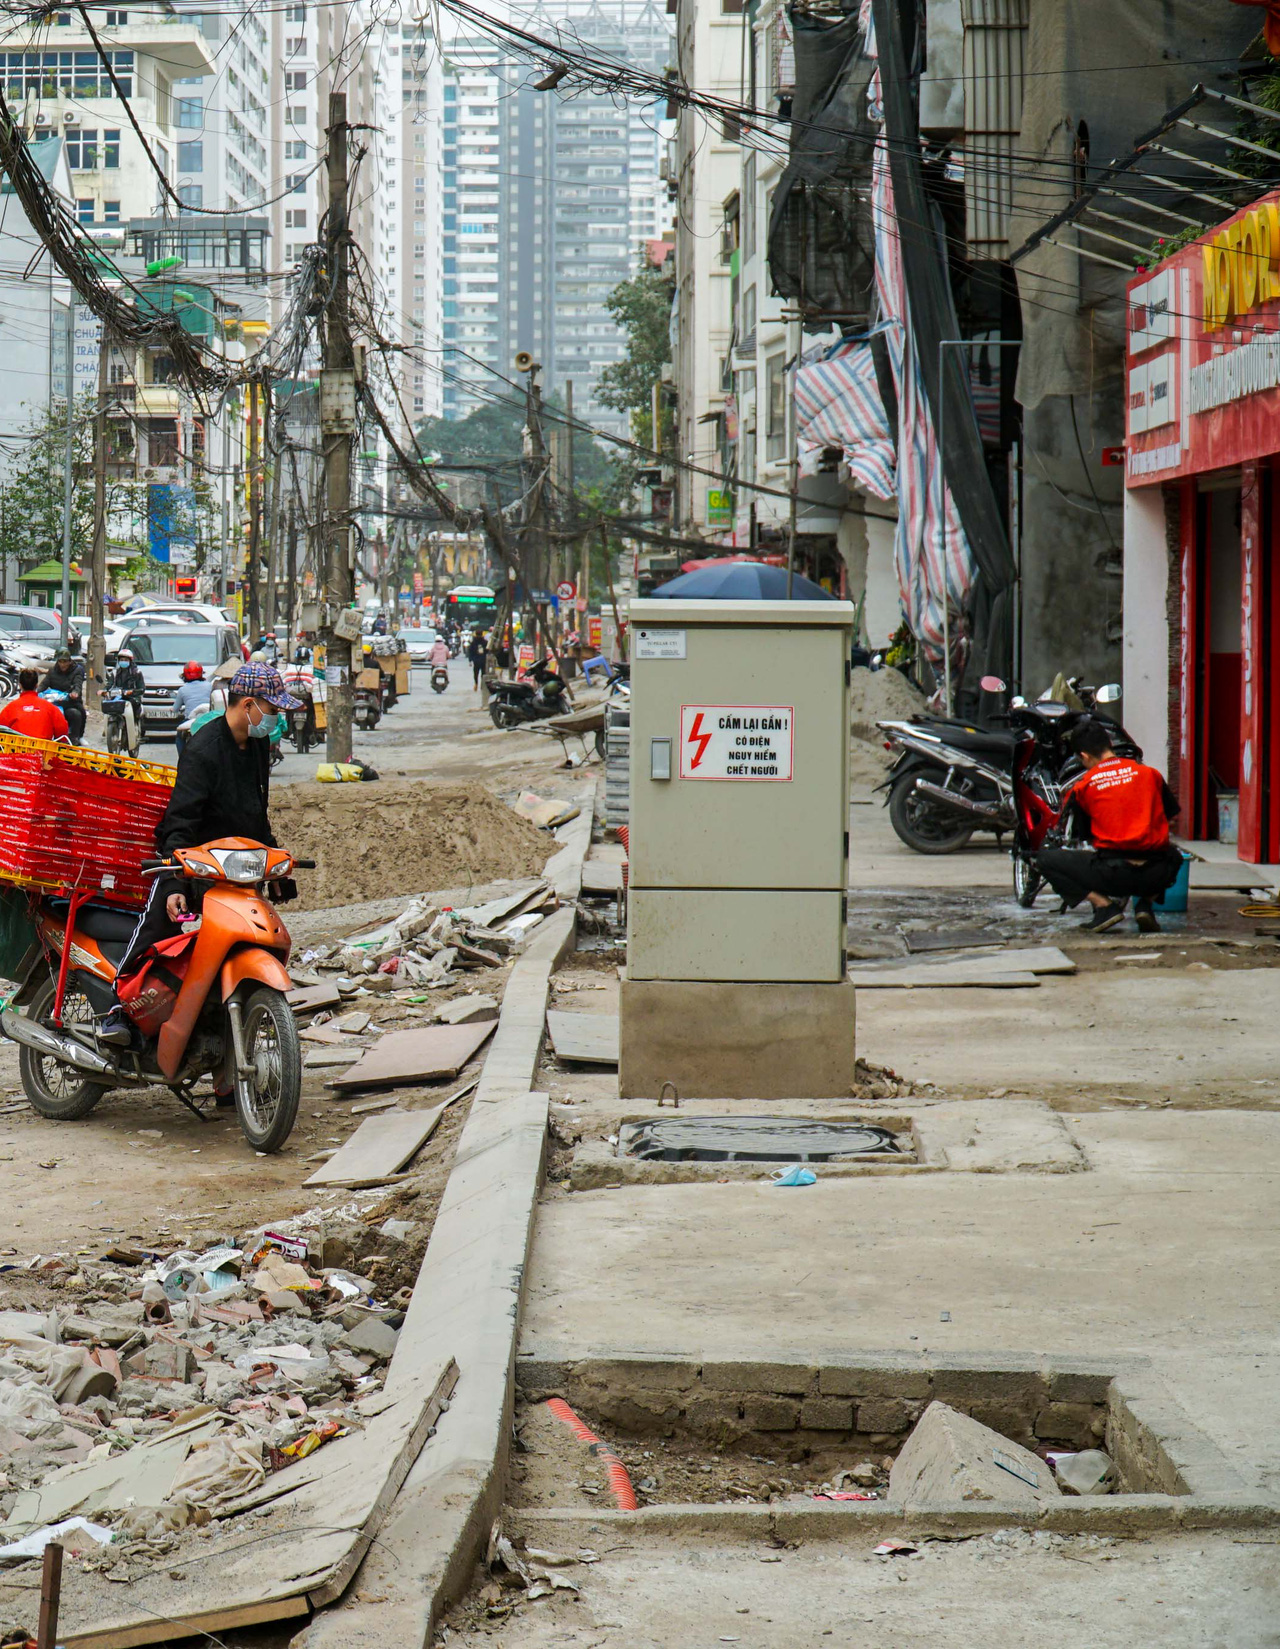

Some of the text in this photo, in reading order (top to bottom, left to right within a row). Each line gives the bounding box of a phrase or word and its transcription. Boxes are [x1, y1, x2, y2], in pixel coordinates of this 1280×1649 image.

[1202, 202, 1275, 332] MOTOR
[719, 714, 741, 730] CẤM
[744, 718, 759, 732] LẠI
[736, 735, 770, 748] CÓ ĐIỆN
[729, 751, 752, 760] NGUY
[727, 763, 778, 775] CHẾT NGƯỜI
[1091, 770, 1117, 780] MOTOR
[1118, 767, 1132, 775] 247
[129, 988, 159, 1010] ninja
